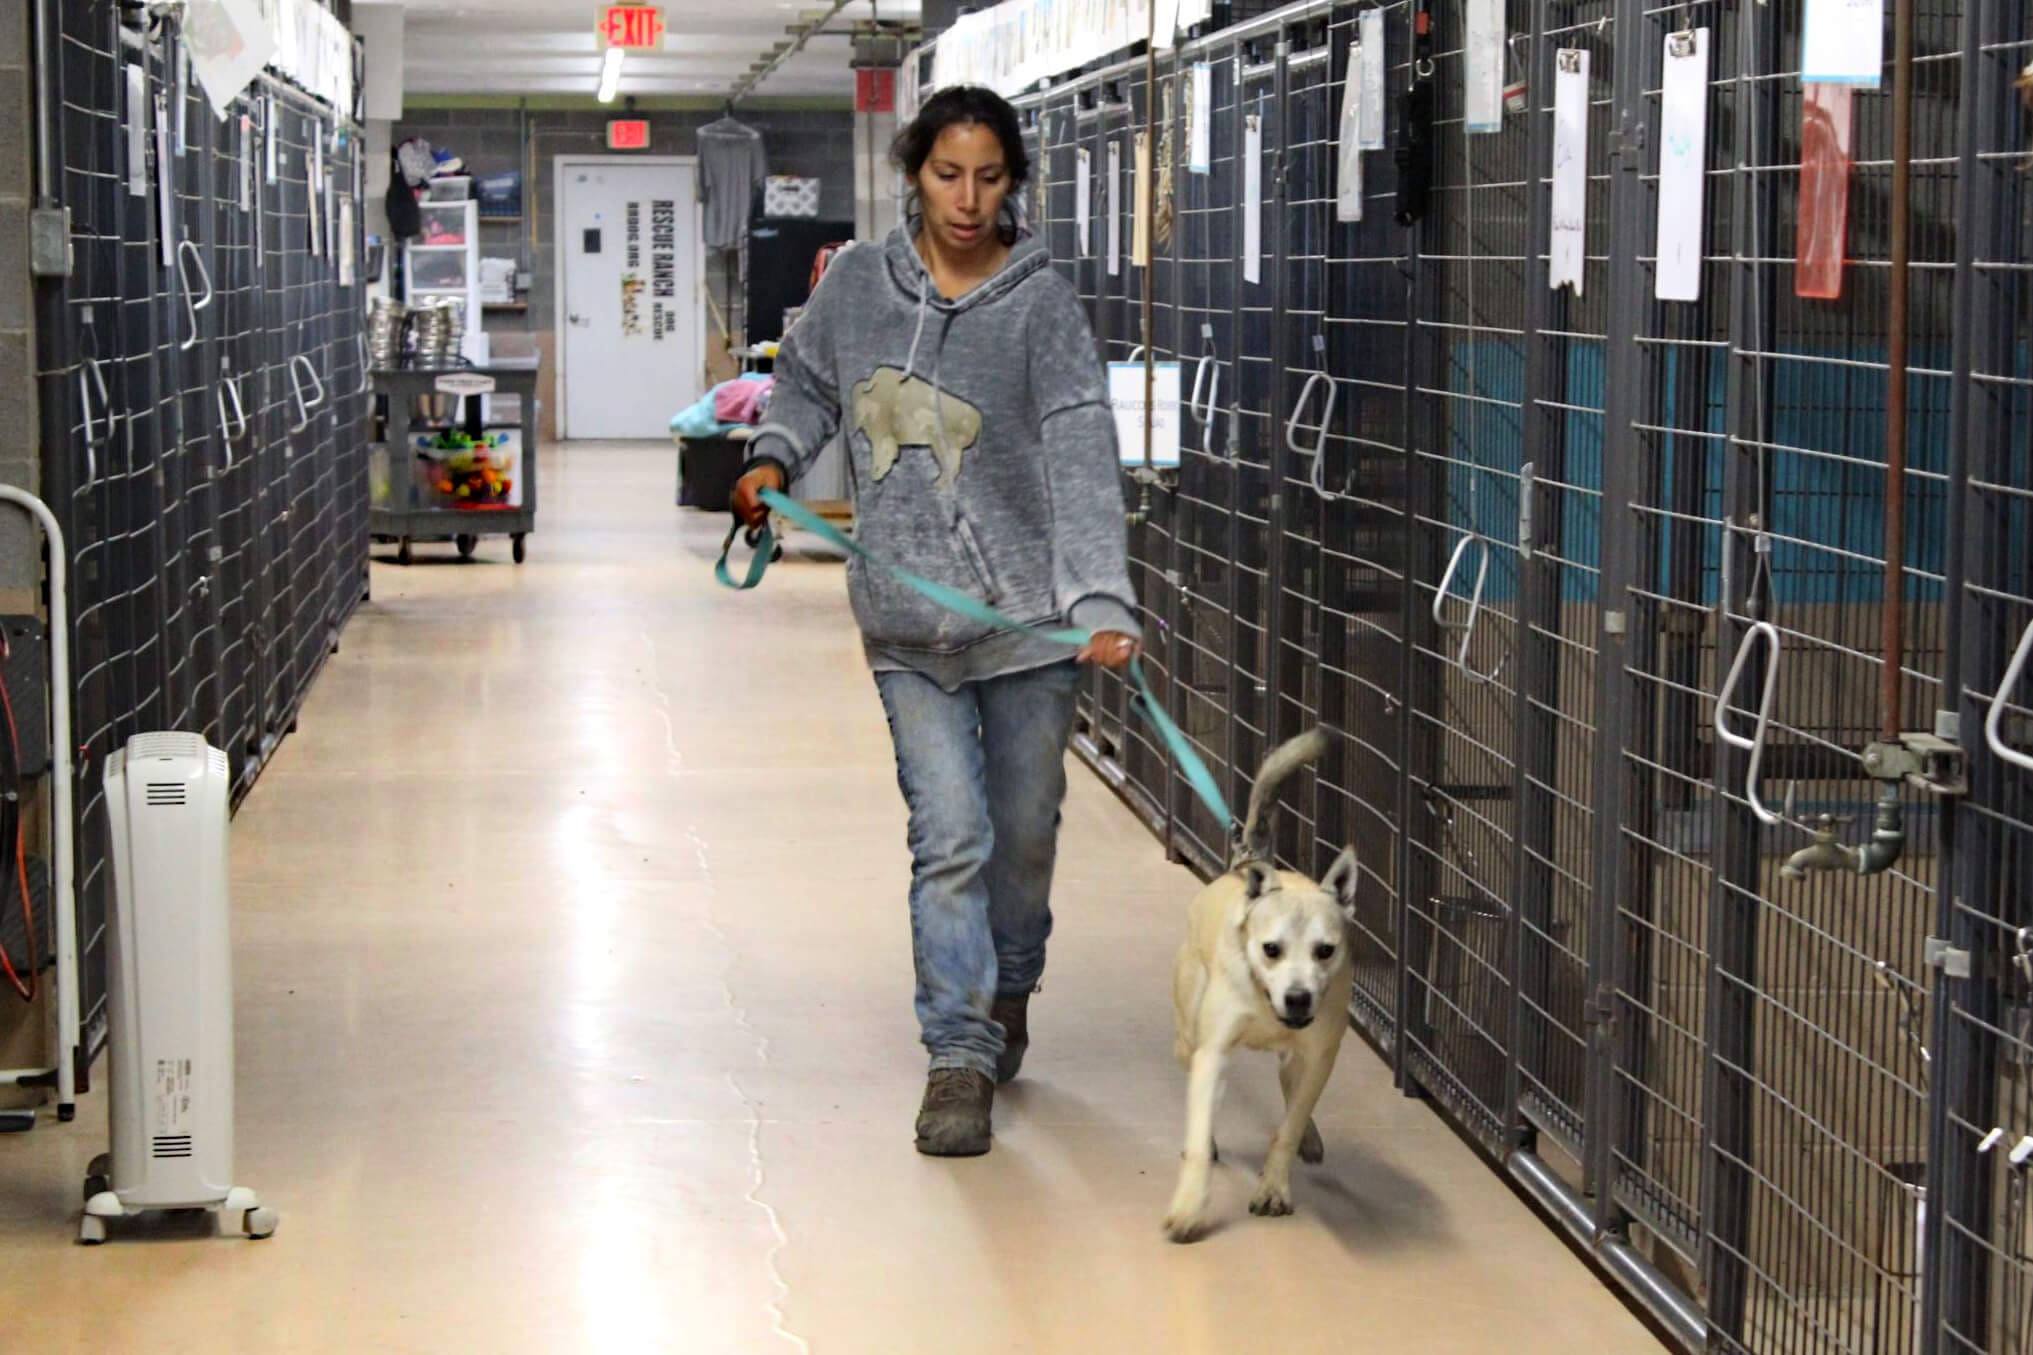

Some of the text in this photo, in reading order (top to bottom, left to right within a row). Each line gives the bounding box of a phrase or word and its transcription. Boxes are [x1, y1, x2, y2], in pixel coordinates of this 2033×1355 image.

[607, 8, 657, 46] EXIT
[652, 200, 674, 297] RESCUE RANCH
